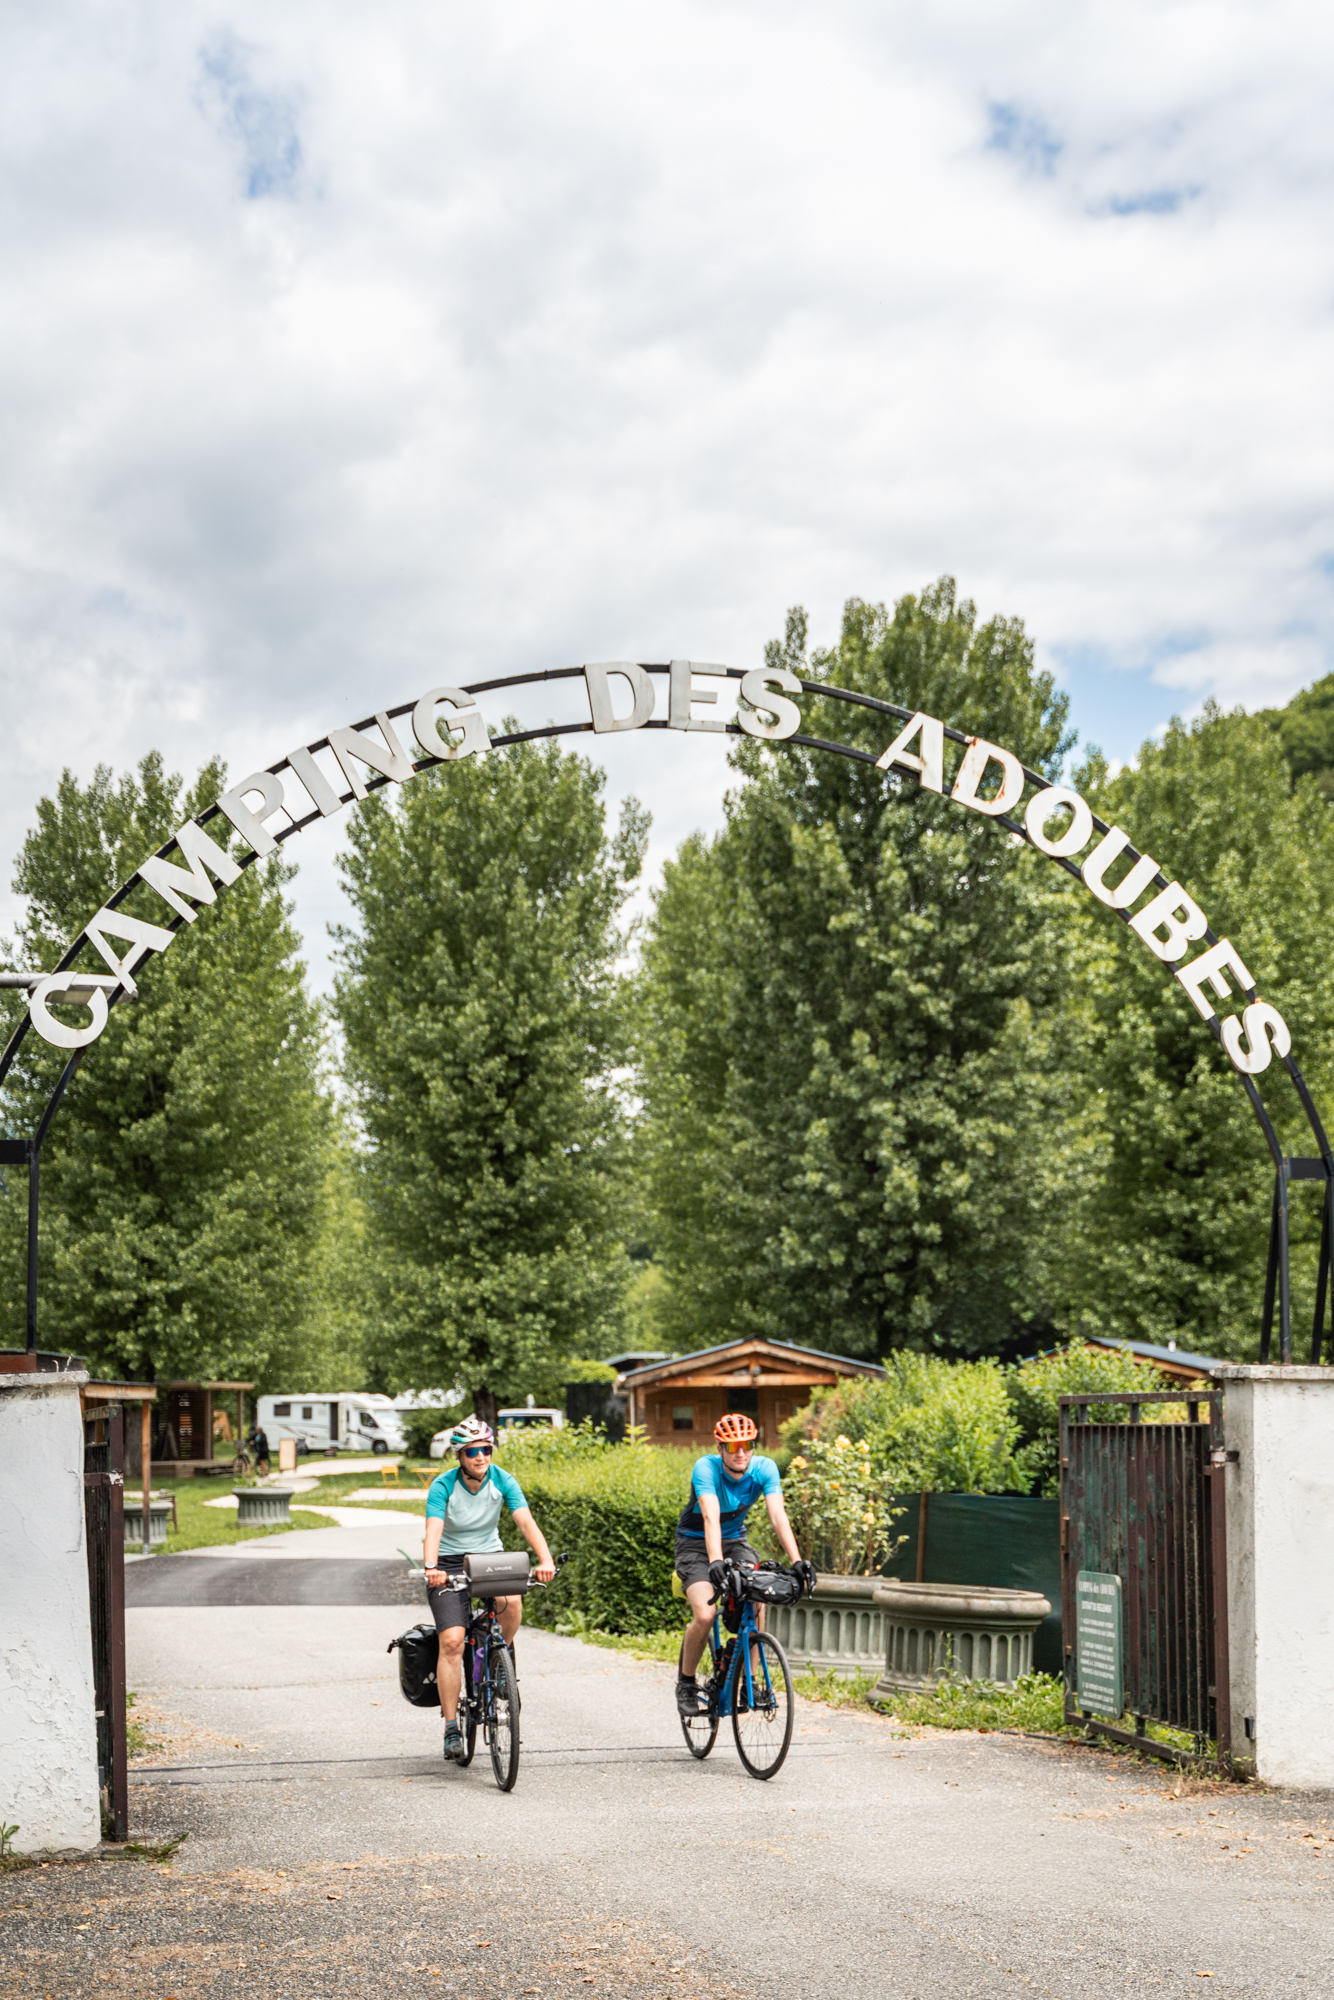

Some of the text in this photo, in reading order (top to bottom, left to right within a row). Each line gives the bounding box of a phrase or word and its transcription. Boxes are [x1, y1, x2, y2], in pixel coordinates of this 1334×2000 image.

[29, 660, 1292, 1075] CAMPING DES ADOUBES
